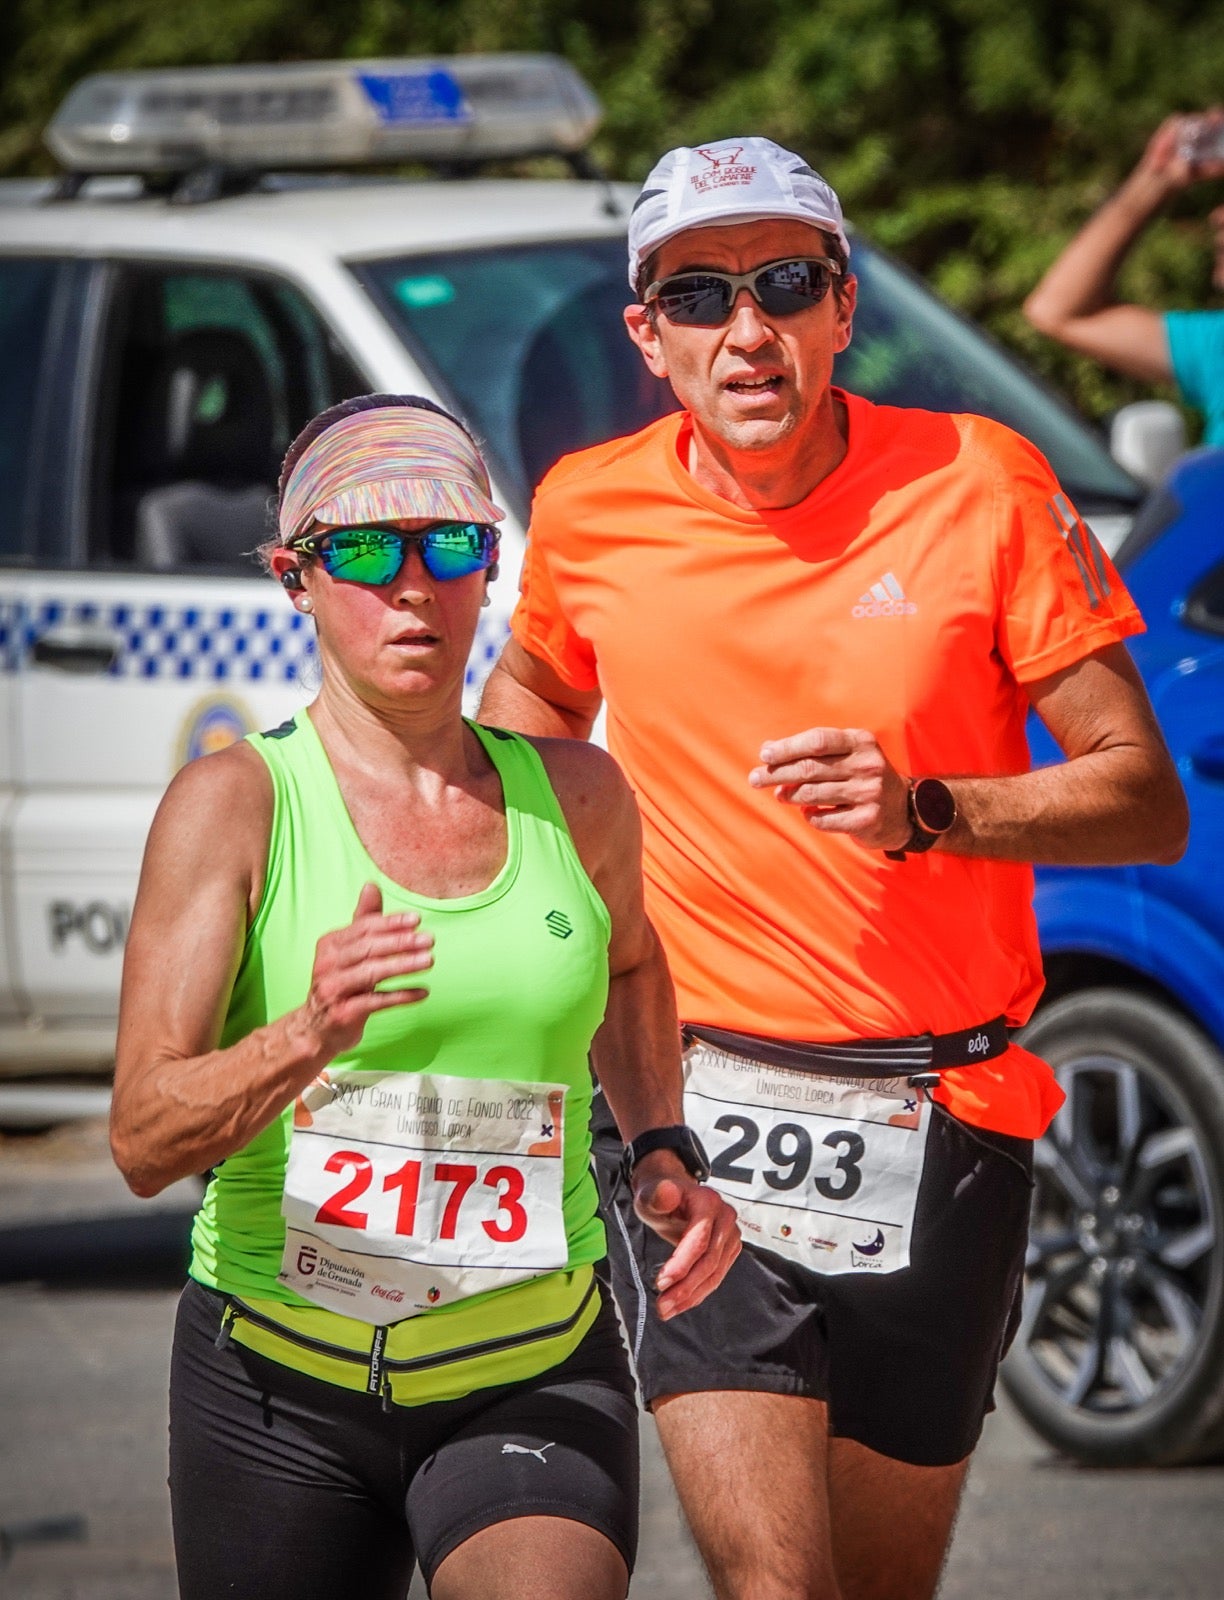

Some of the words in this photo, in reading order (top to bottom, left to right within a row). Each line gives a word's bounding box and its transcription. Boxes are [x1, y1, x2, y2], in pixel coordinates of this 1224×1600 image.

[851, 600, 918, 619] adidas
[967, 1032, 990, 1055] edp
[733, 1053, 761, 1075] GRAN
[370, 1086, 402, 1110] GRAN
[466, 1097, 504, 1120] FONDO
[506, 1098, 536, 1122] 2022
[710, 1113, 866, 1201] 293
[314, 1149, 528, 1243] 2173
[319, 1256, 365, 1279] Diputación
[327, 1270, 363, 1289] Granada
